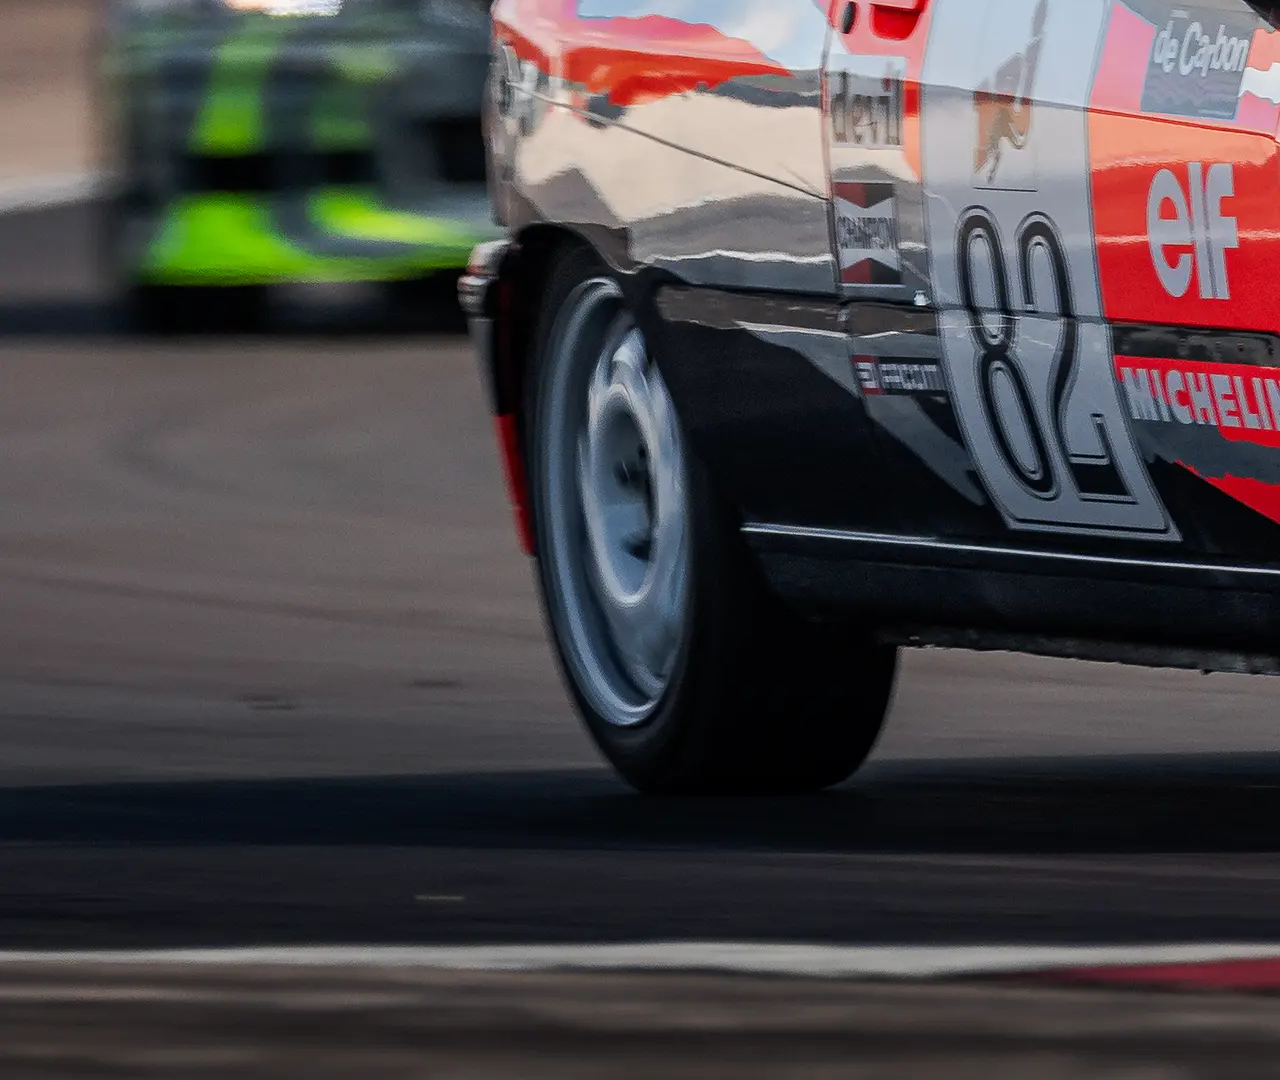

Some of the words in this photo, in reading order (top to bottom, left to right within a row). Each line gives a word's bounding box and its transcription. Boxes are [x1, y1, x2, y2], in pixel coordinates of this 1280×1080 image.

[1153, 20, 1177, 74] de
[1179, 21, 1249, 78] Carbon
[1146, 161, 1240, 300] elf
[953, 204, 1140, 502] 82
